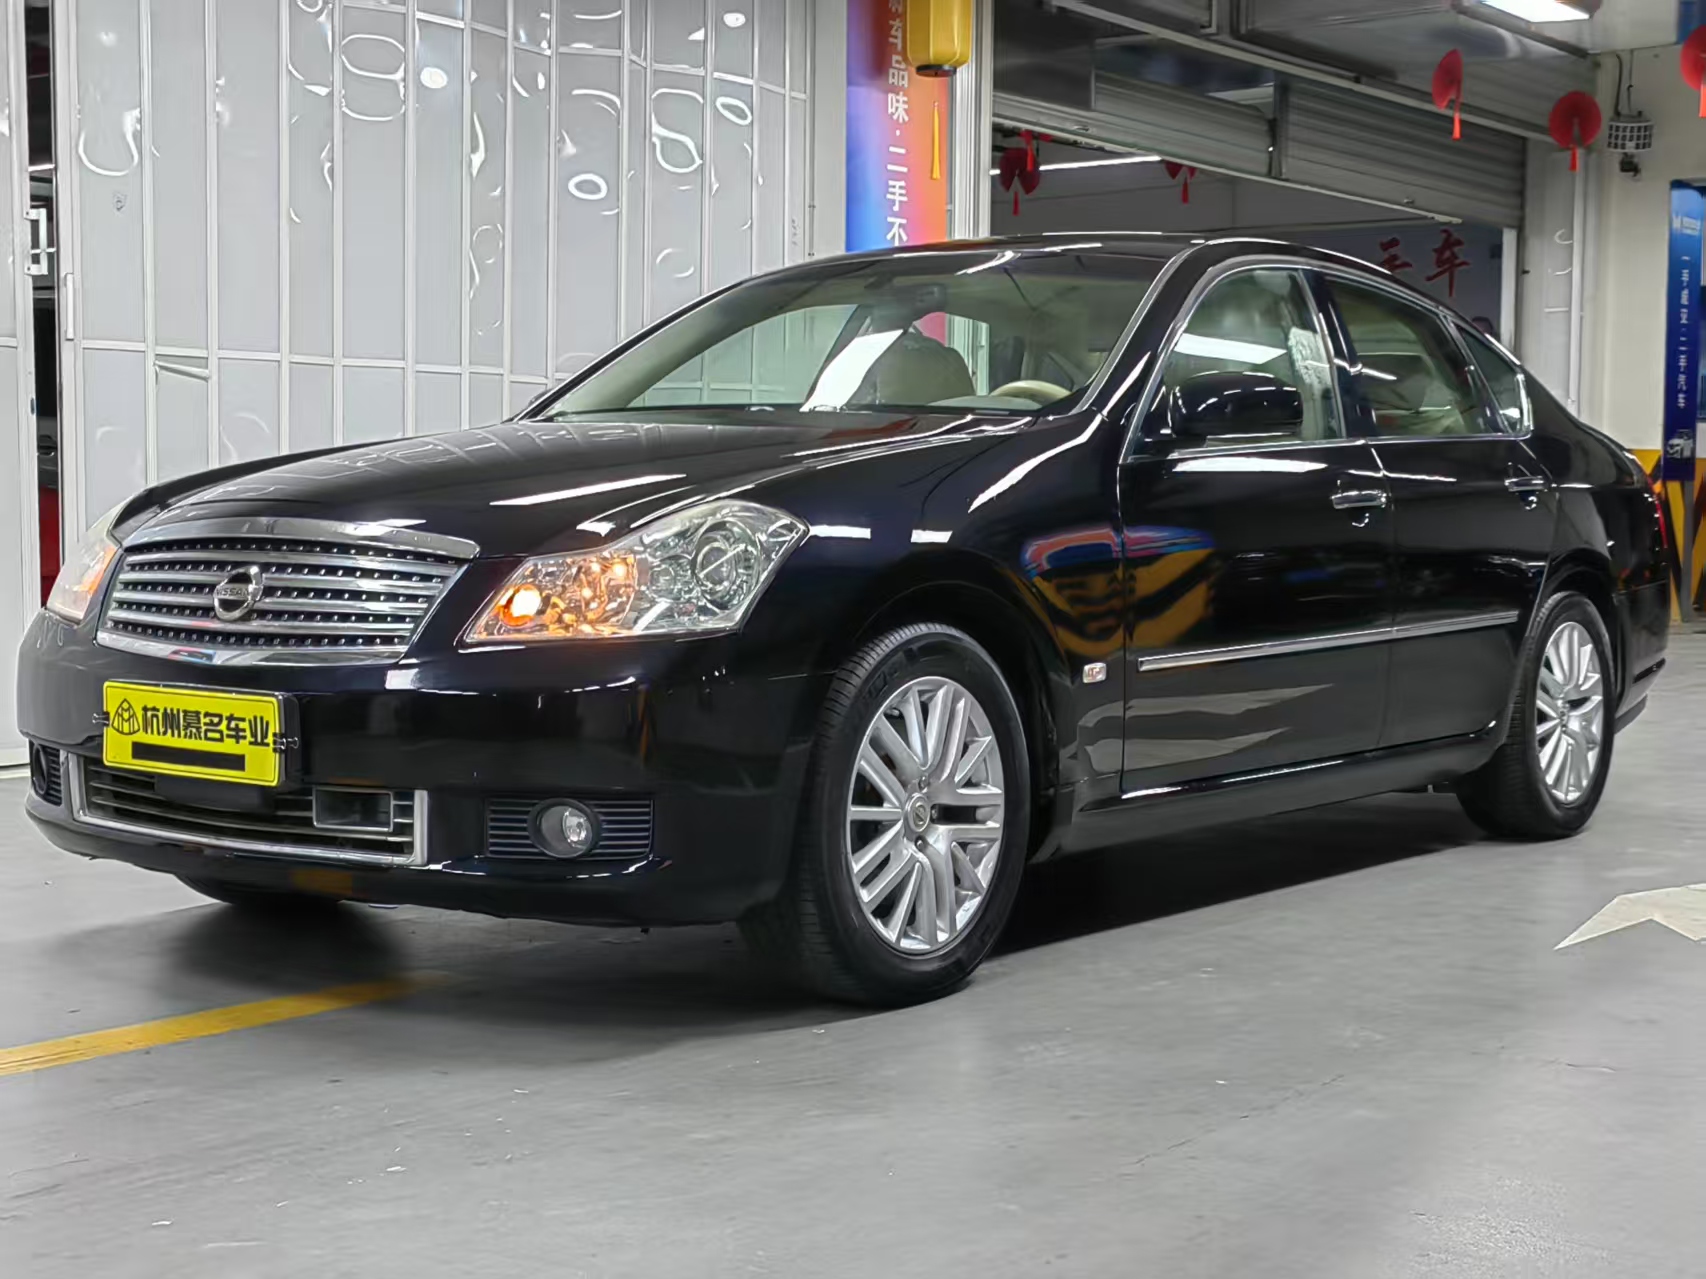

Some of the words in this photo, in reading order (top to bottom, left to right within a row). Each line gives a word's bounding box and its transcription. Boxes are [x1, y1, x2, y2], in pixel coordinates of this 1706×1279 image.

[216, 586, 250, 598] NISSAN
[141, 705, 271, 747] 杭州慕名车业
